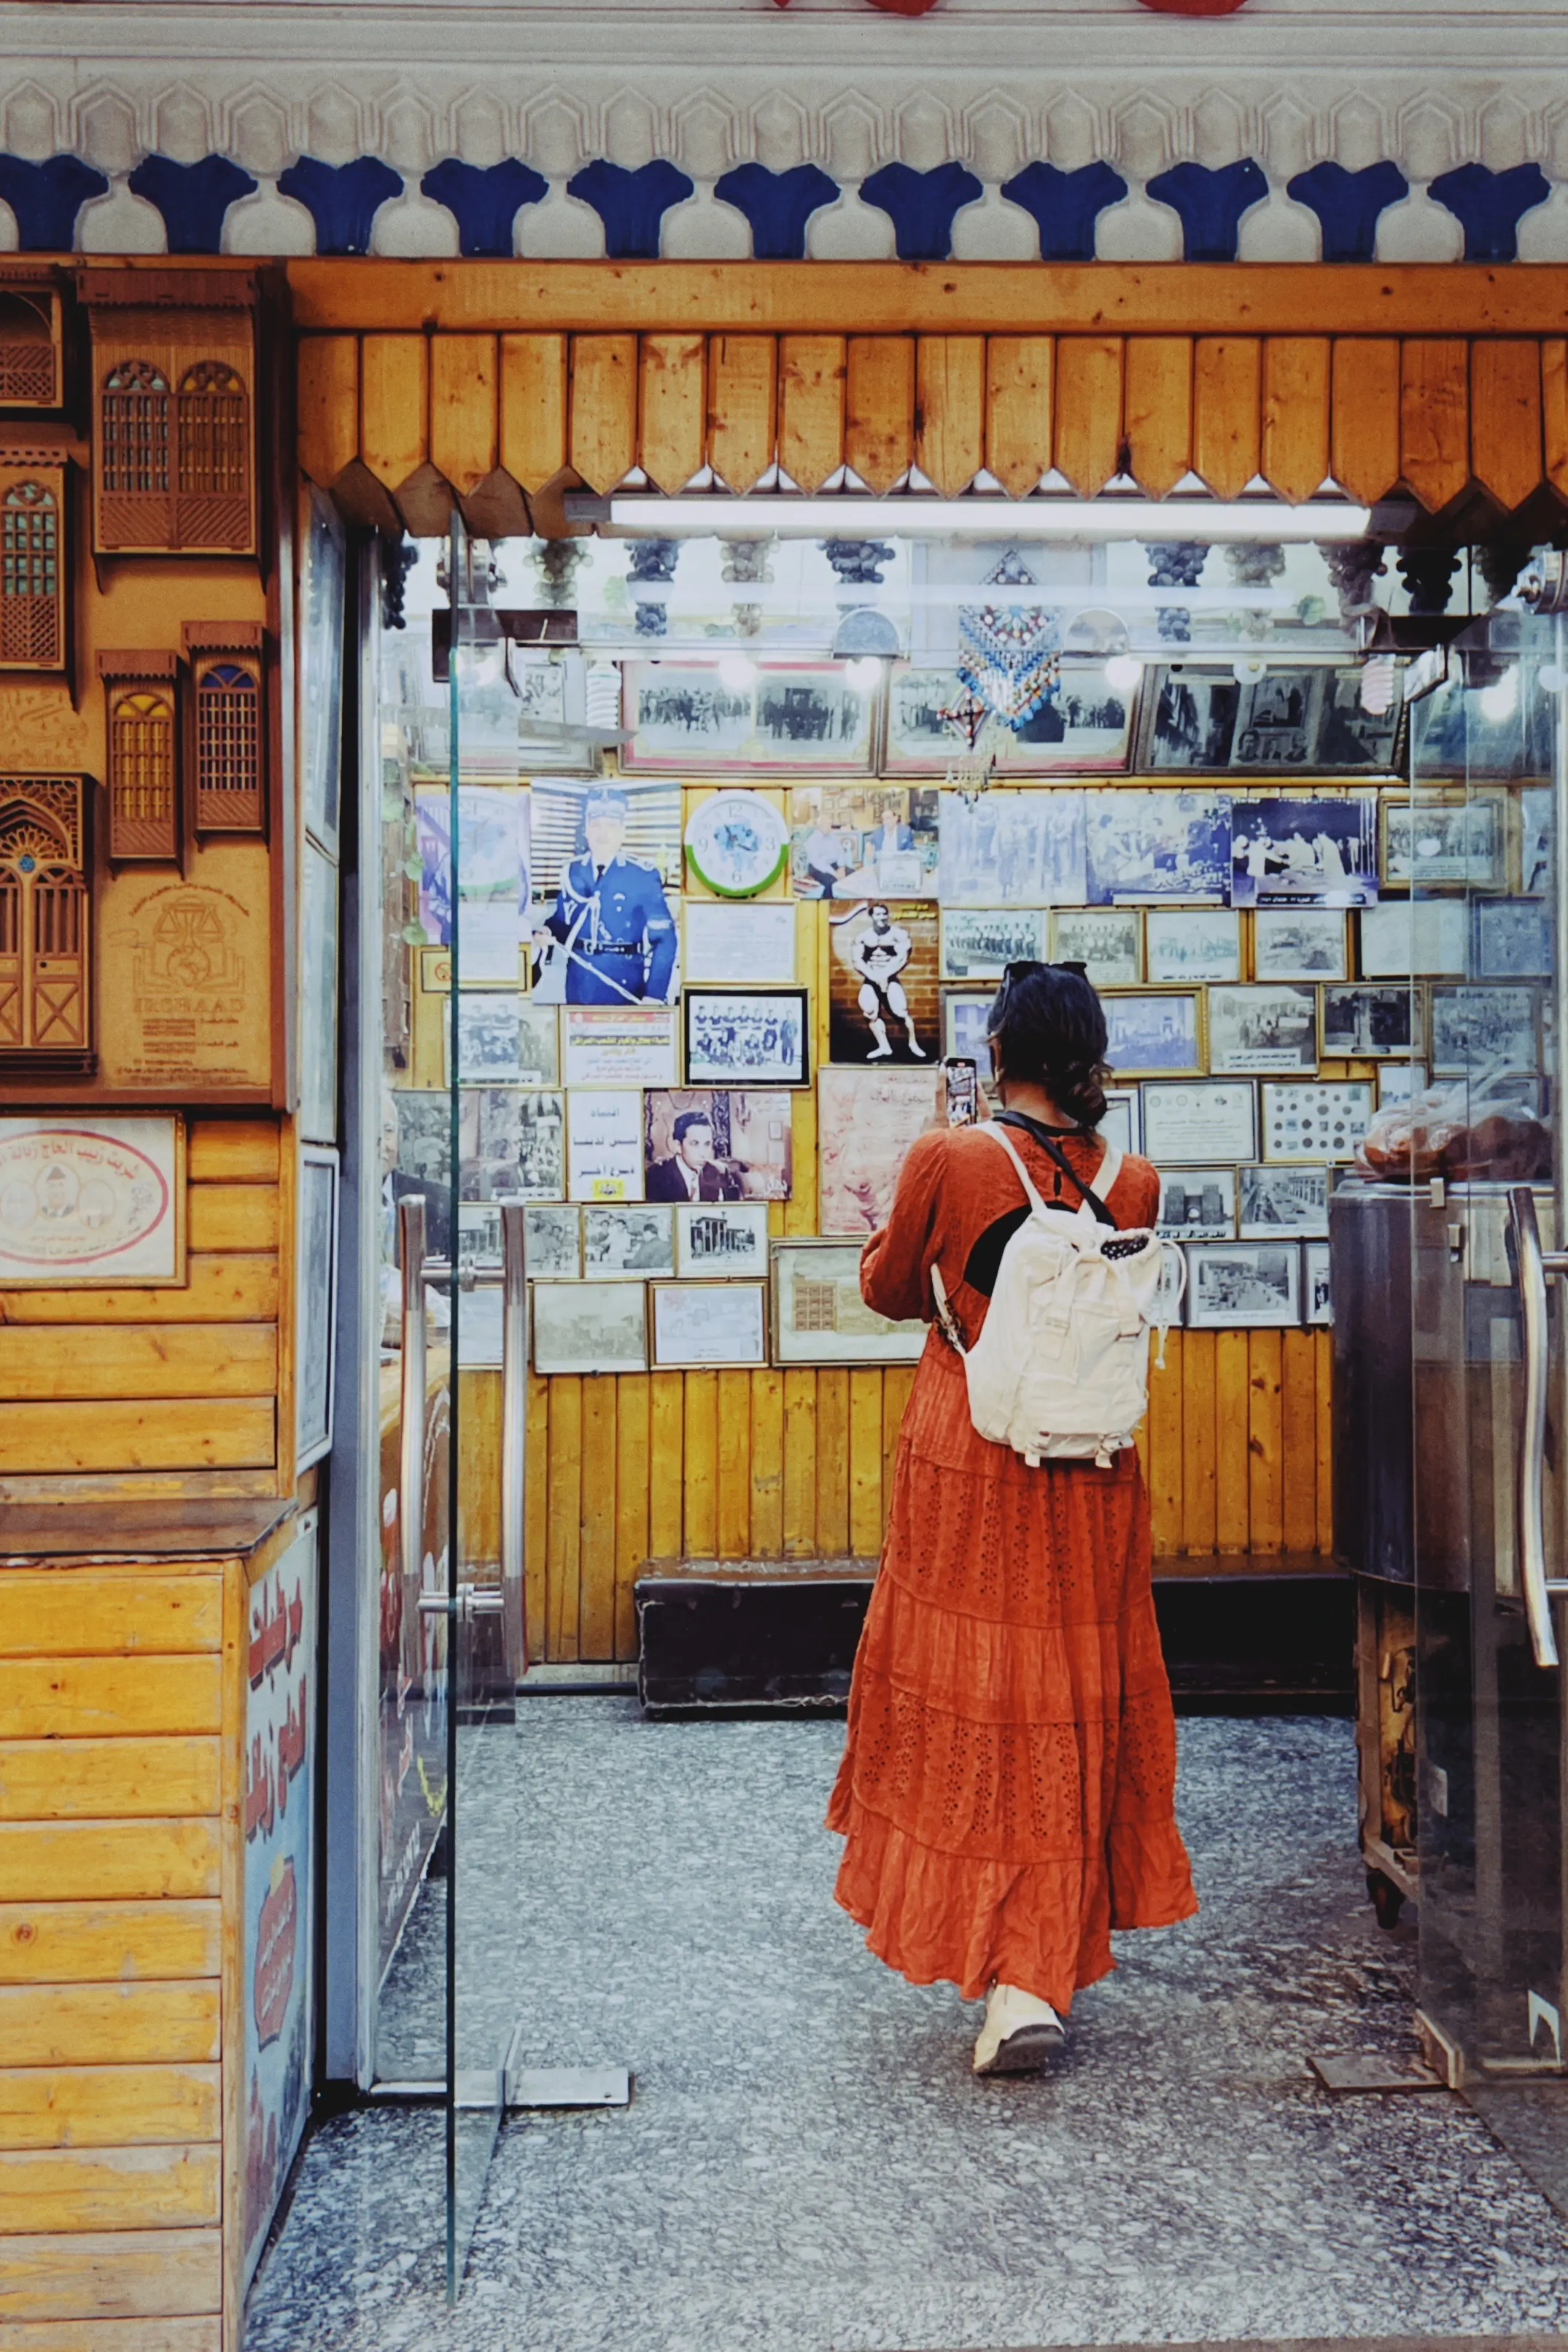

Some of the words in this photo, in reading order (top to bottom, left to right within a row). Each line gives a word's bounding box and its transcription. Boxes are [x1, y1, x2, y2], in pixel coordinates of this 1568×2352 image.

[728, 804, 742, 818] 12
[698, 837, 709, 853] 9
[765, 836, 775, 851] 3
[731, 868, 742, 883] 6
[573, 1135, 605, 1146] لدينا
[609, 1135, 638, 1148] ليس
[41, 1140, 74, 1160] الحاج
